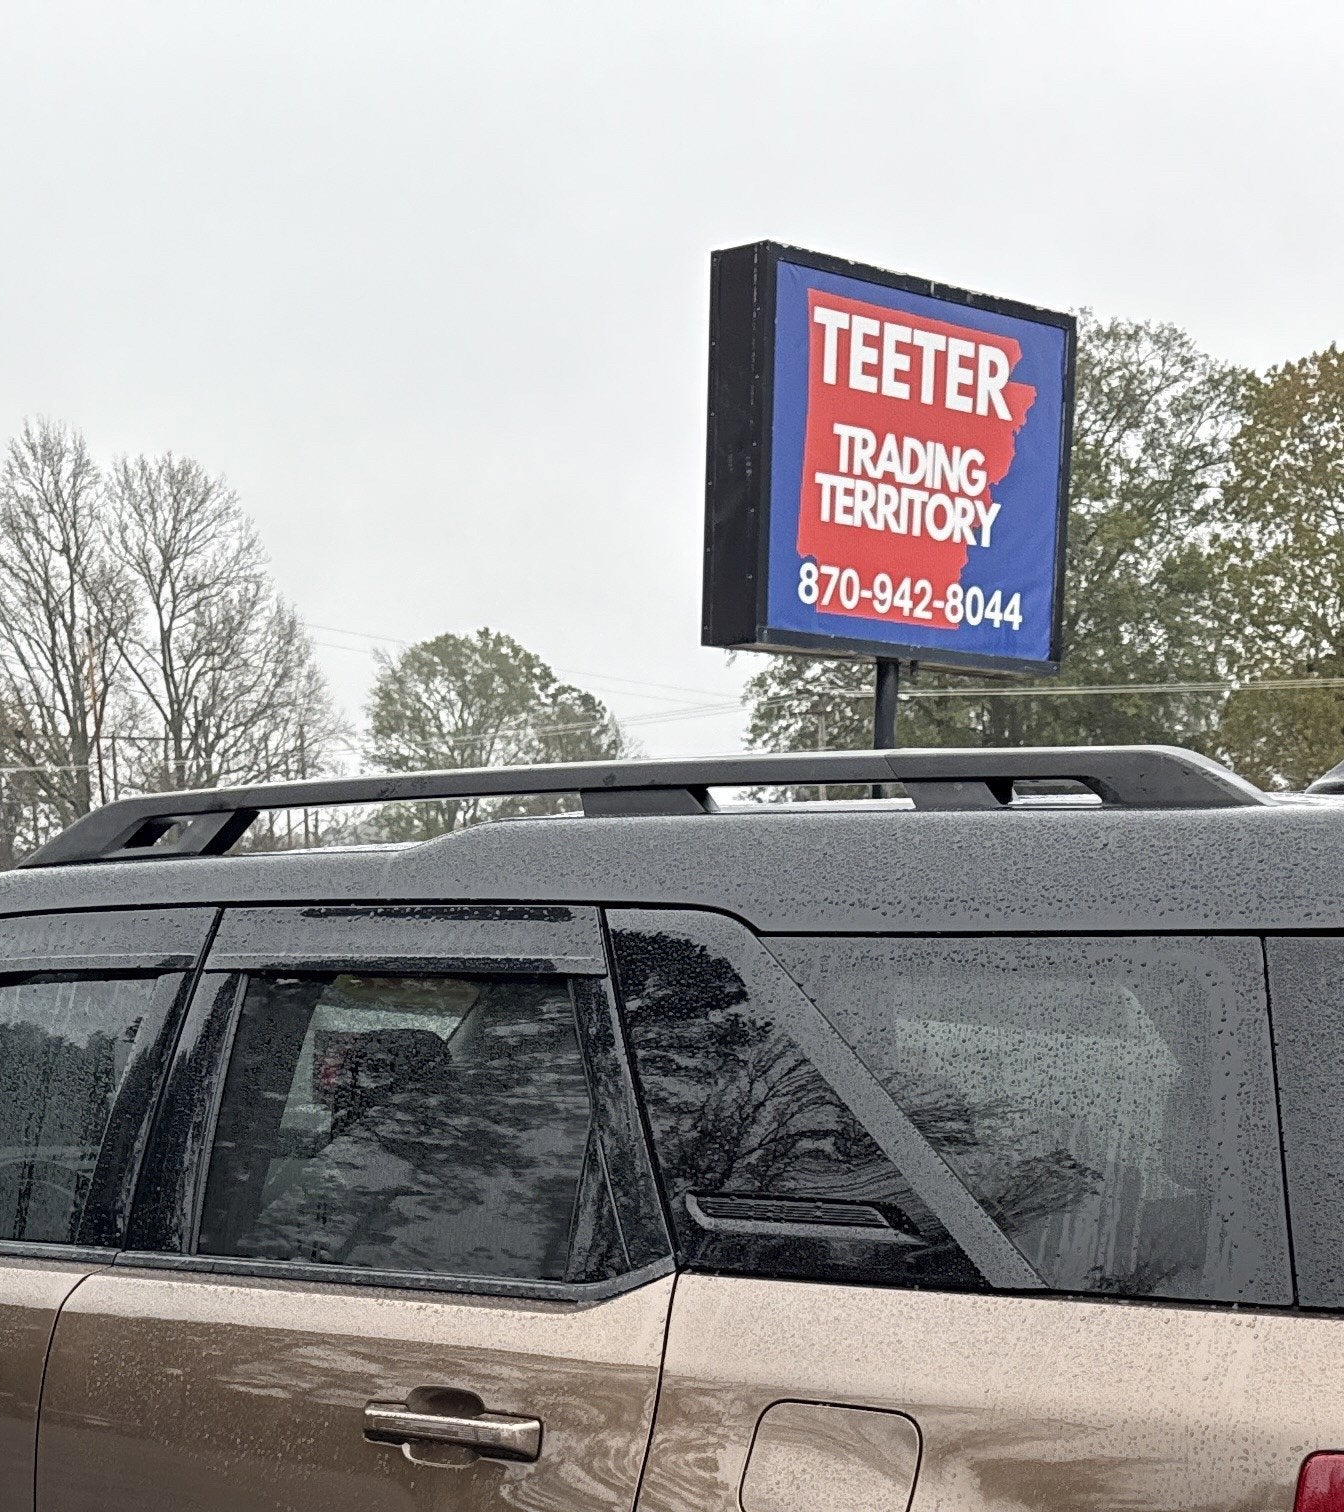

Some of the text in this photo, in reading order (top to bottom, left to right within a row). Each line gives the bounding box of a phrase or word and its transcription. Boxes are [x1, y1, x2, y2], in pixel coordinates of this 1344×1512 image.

[814, 306, 1013, 421] TEETER
[833, 423, 987, 497] TRADING
[814, 472, 1002, 548] TERRITORY
[797, 562, 1023, 630] 870-942-8044
